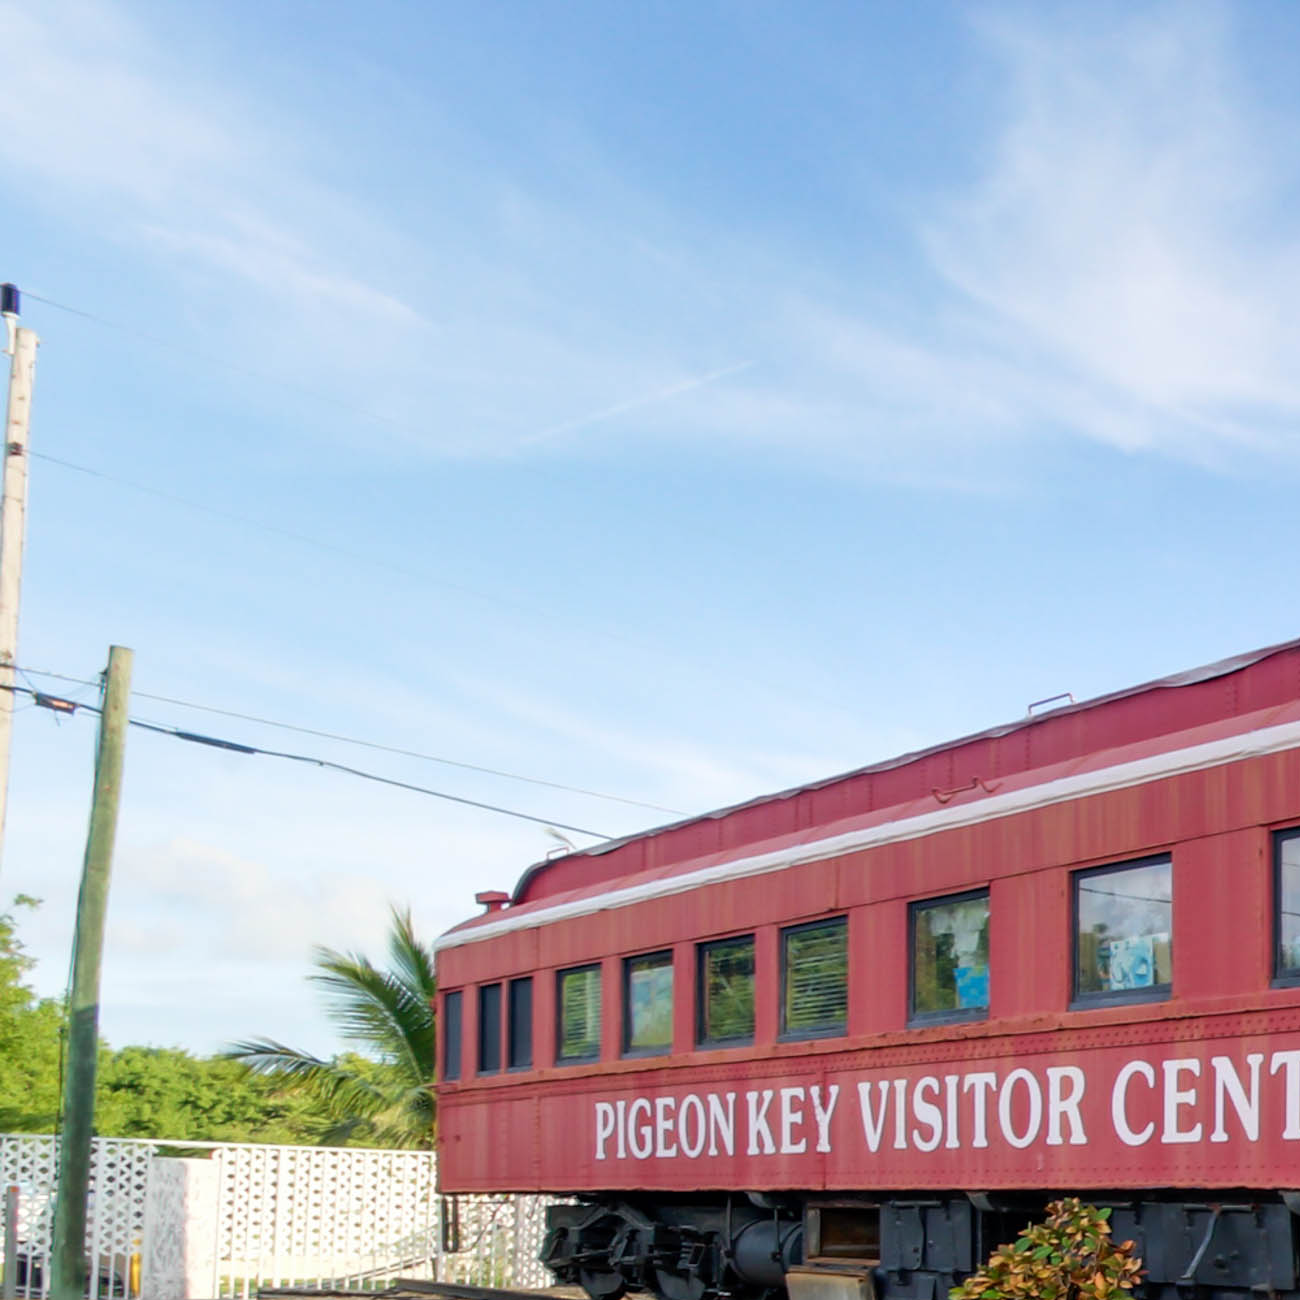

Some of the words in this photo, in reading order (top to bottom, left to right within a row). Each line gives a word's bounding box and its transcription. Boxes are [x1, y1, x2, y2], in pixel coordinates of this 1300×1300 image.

[594, 1092, 736, 1160] PIGEON
[745, 1084, 841, 1156] KEY
[857, 1065, 1088, 1153] VISITOR
